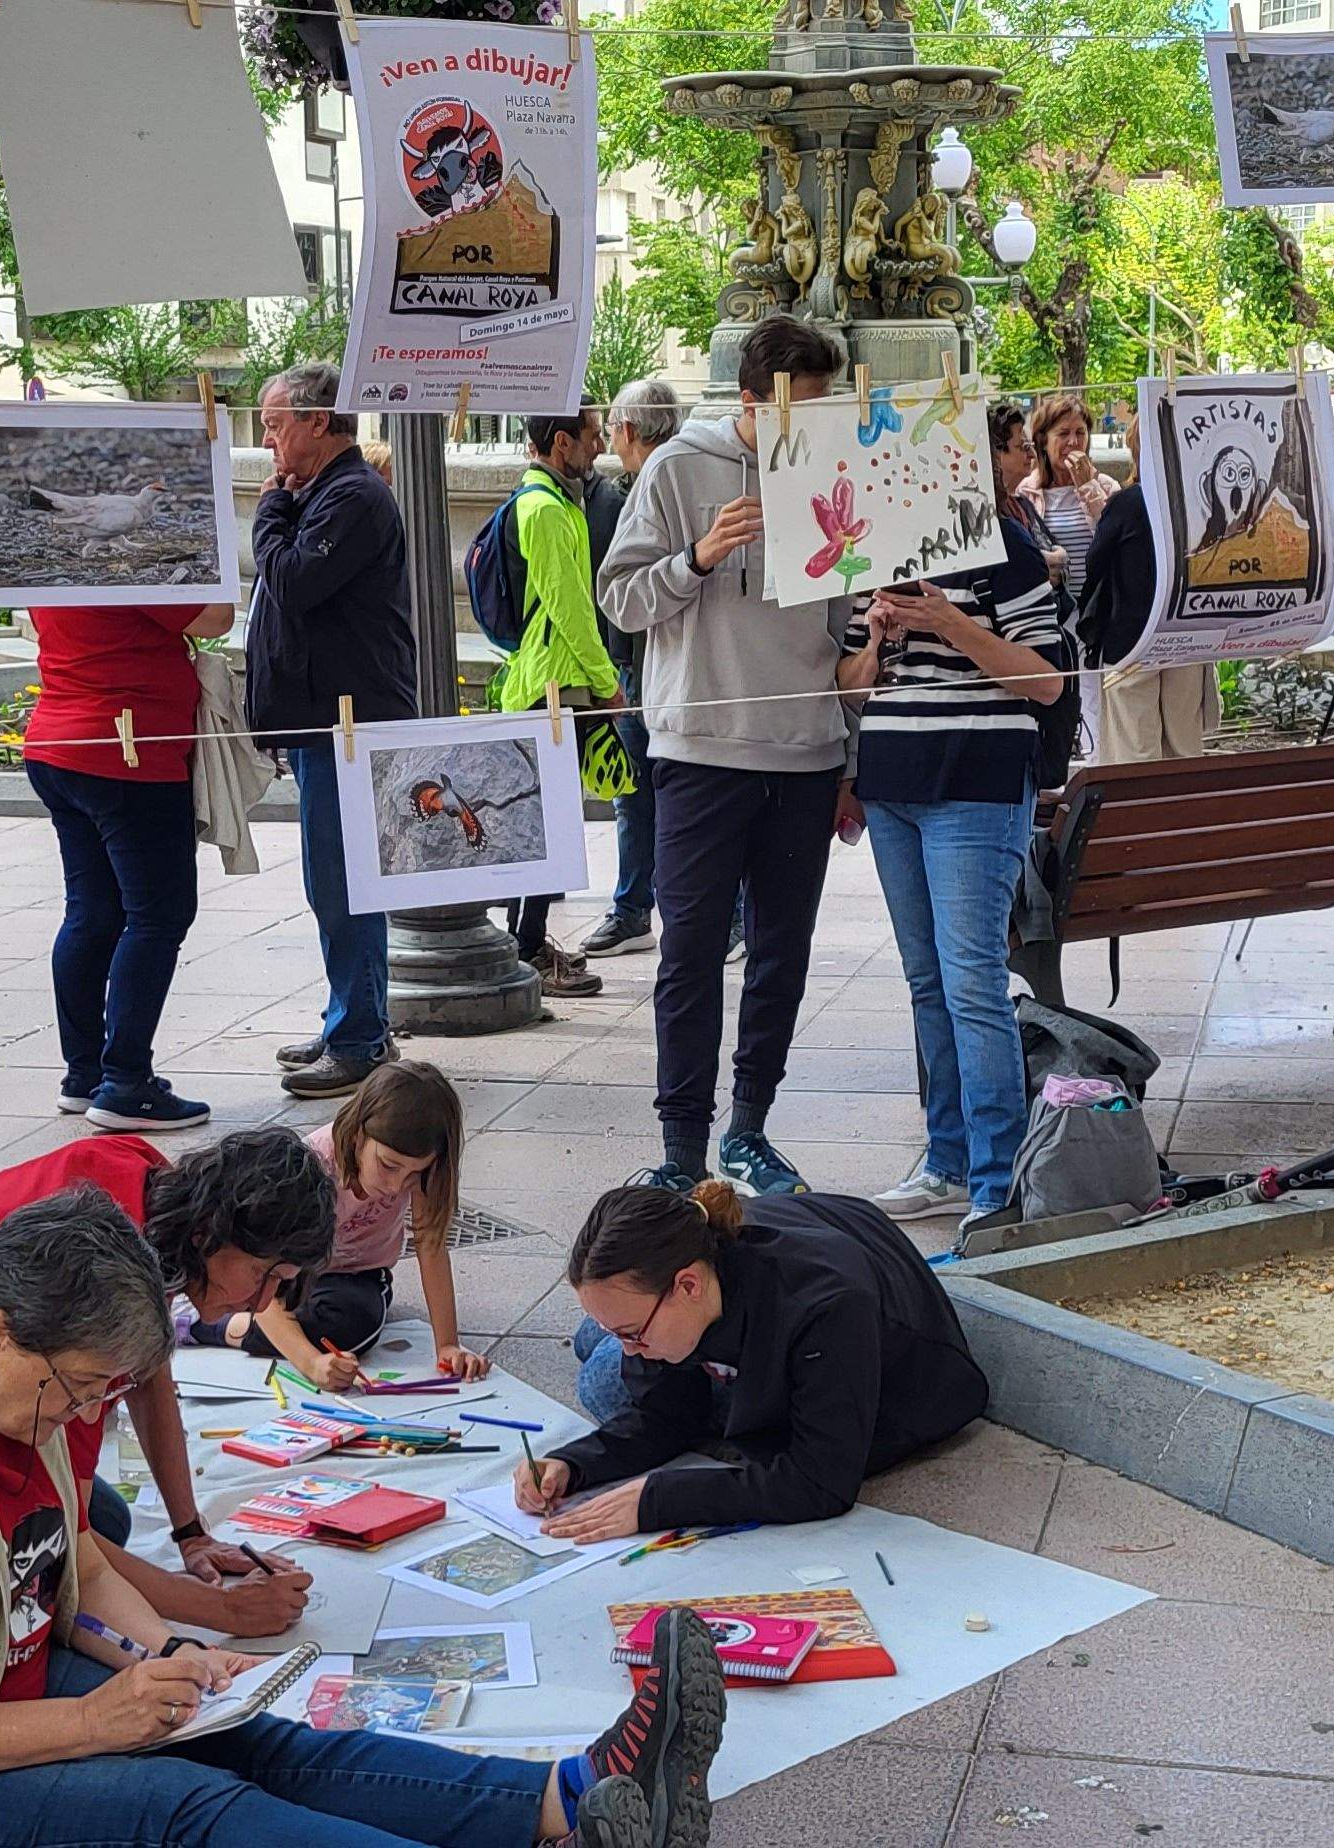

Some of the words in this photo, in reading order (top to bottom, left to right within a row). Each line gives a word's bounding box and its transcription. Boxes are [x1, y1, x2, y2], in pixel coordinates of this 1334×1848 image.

[379, 57, 438, 88] ¡Ven
[444, 55, 460, 71] a
[466, 47, 573, 92] dibujar!
[505, 95, 552, 109] HUESCA
[506, 110, 534, 124] Plaza
[536, 110, 576, 125] Navarra
[452, 244, 494, 265] POR
[401, 283, 479, 308] CANAL
[487, 285, 540, 310] ROYA
[469, 320, 515, 338] Domingo
[517, 317, 529, 328] 14
[530, 313, 543, 324] de
[543, 307, 570, 322] mayo
[371, 345, 396, 364] ¡Te
[398, 346, 491, 363] esperamos!
[1183, 399, 1278, 450] ARTISTAS
[1228, 557, 1263, 576] POR
[1188, 592, 1246, 611] CANAL
[1255, 590, 1298, 611] ROYA
[1154, 635, 1194, 646] HUESCA
[1256, 637, 1310, 649] dibujar!
